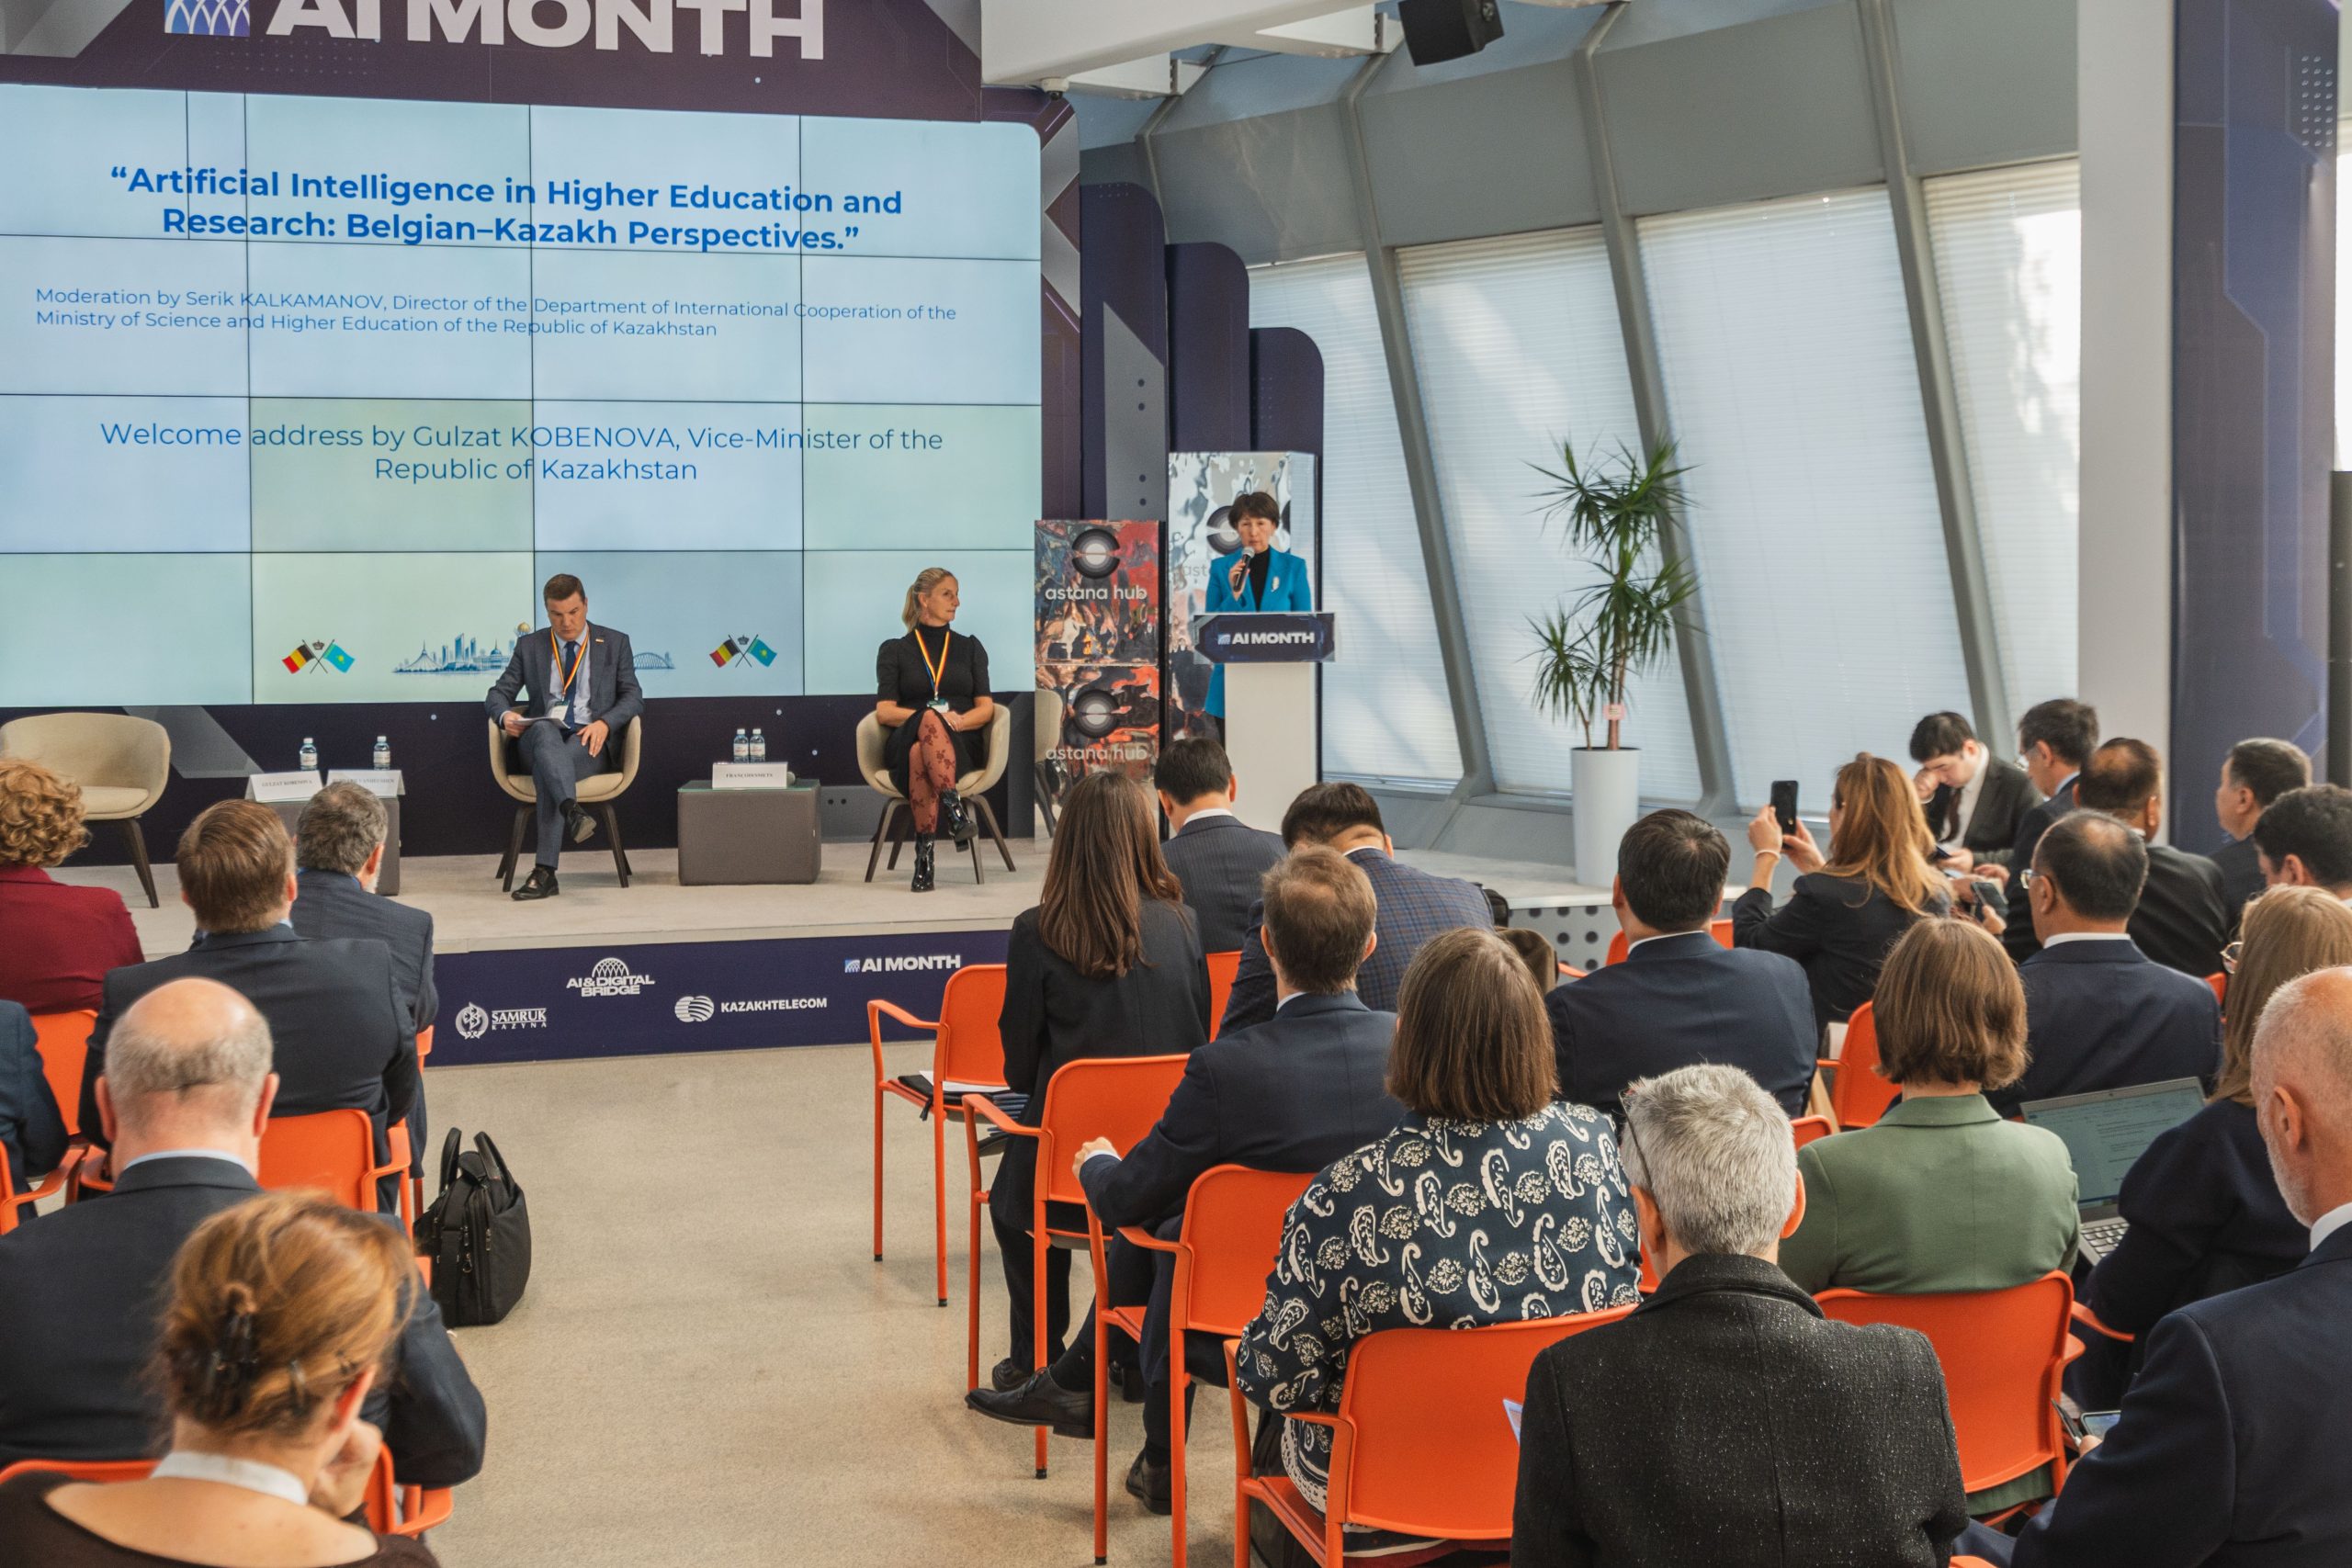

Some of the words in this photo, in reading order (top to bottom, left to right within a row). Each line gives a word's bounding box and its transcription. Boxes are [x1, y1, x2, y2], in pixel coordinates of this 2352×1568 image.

[407, 0, 824, 61] MONTH
[110, 165, 279, 197] “Artificial
[291, 172, 495, 206] Intelligence
[505, 177, 537, 204] in
[548, 180, 660, 213] Higher
[670, 184, 834, 213] Education
[842, 190, 903, 215] and
[163, 208, 336, 238] Research:
[628, 220, 860, 254] Perspectives.”
[35, 288, 152, 306] Moderation
[156, 289, 181, 310] by
[186, 290, 235, 308] Serik
[241, 292, 390, 313] KALKAMANOV,
[393, 294, 469, 312] Director
[473, 295, 493, 312] of
[496, 296, 527, 313] the
[533, 297, 648, 320] Department
[651, 299, 672, 316] of
[673, 299, 789, 318] International
[794, 303, 903, 325] Cooperation
[906, 303, 926, 321] of
[928, 304, 957, 321] the
[35, 310, 116, 330] Ministry
[120, 311, 141, 328] of
[144, 311, 222, 329] Science
[226, 312, 266, 330] and
[270, 313, 336, 334] Higher
[342, 314, 439, 333] Education
[443, 315, 463, 333] of
[466, 316, 498, 333] the
[503, 317, 586, 338] Republic
[589, 319, 610, 335] of
[613, 320, 718, 337] Kazakhstan
[100, 422, 242, 446] Welcome
[251, 423, 364, 447] address
[372, 425, 405, 452] by
[413, 425, 502, 447] Gulzat
[511, 426, 681, 452] KOBENOVA,
[687, 426, 865, 450] Vice-Minister
[868, 428, 895, 450] of
[899, 428, 944, 450] the
[375, 457, 499, 485] Republic
[505, 458, 533, 480] of
[542, 458, 697, 480] Kazakhstan
[1045, 586, 1108, 601] astana
[1113, 584, 1148, 600] hub
[1231, 631, 1250, 645] AI
[1250, 631, 1316, 645] MONTH
[1045, 746, 1108, 761] astana
[1113, 745, 1148, 761] hub
[861, 957, 882, 973] AI
[885, 954, 961, 972] MONTH
[581, 984, 640, 998] BRIDGE
[720, 997, 828, 1013] KAZAKHTELECOM
[492, 1010, 547, 1022] SAMRUK
[492, 1021, 548, 1031] KAZYNA
